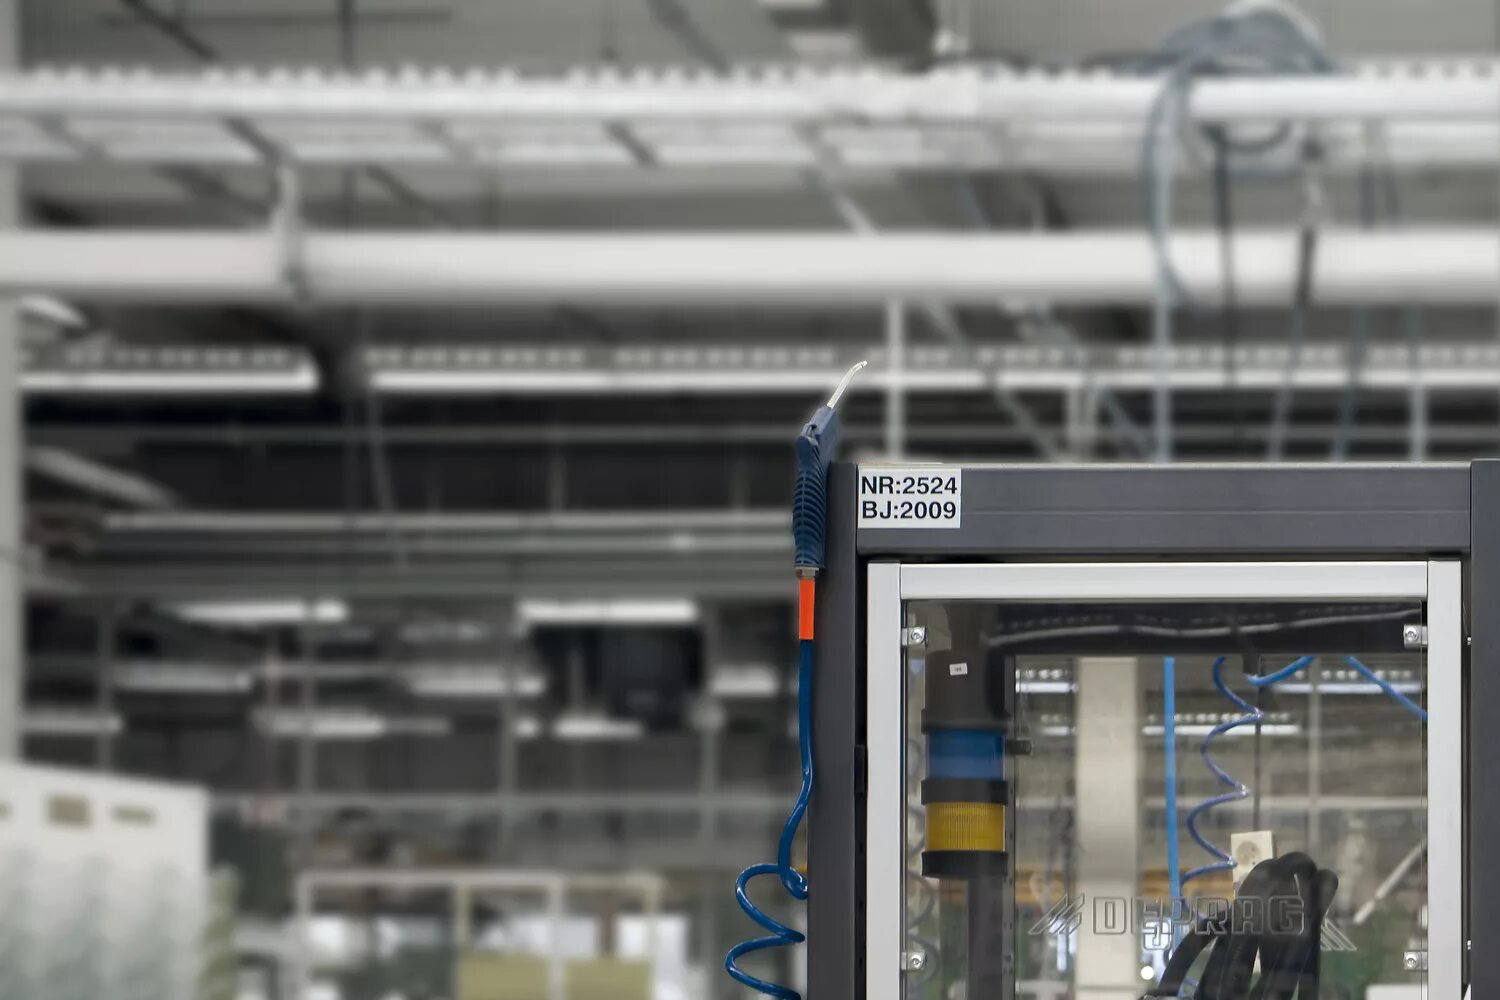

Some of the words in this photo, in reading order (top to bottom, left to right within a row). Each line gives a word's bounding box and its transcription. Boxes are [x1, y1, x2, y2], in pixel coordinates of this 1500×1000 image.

[861, 475, 958, 495] NR:2524
[862, 500, 957, 519] BJ:2009
[1092, 895, 1305, 936] DEPRAG
